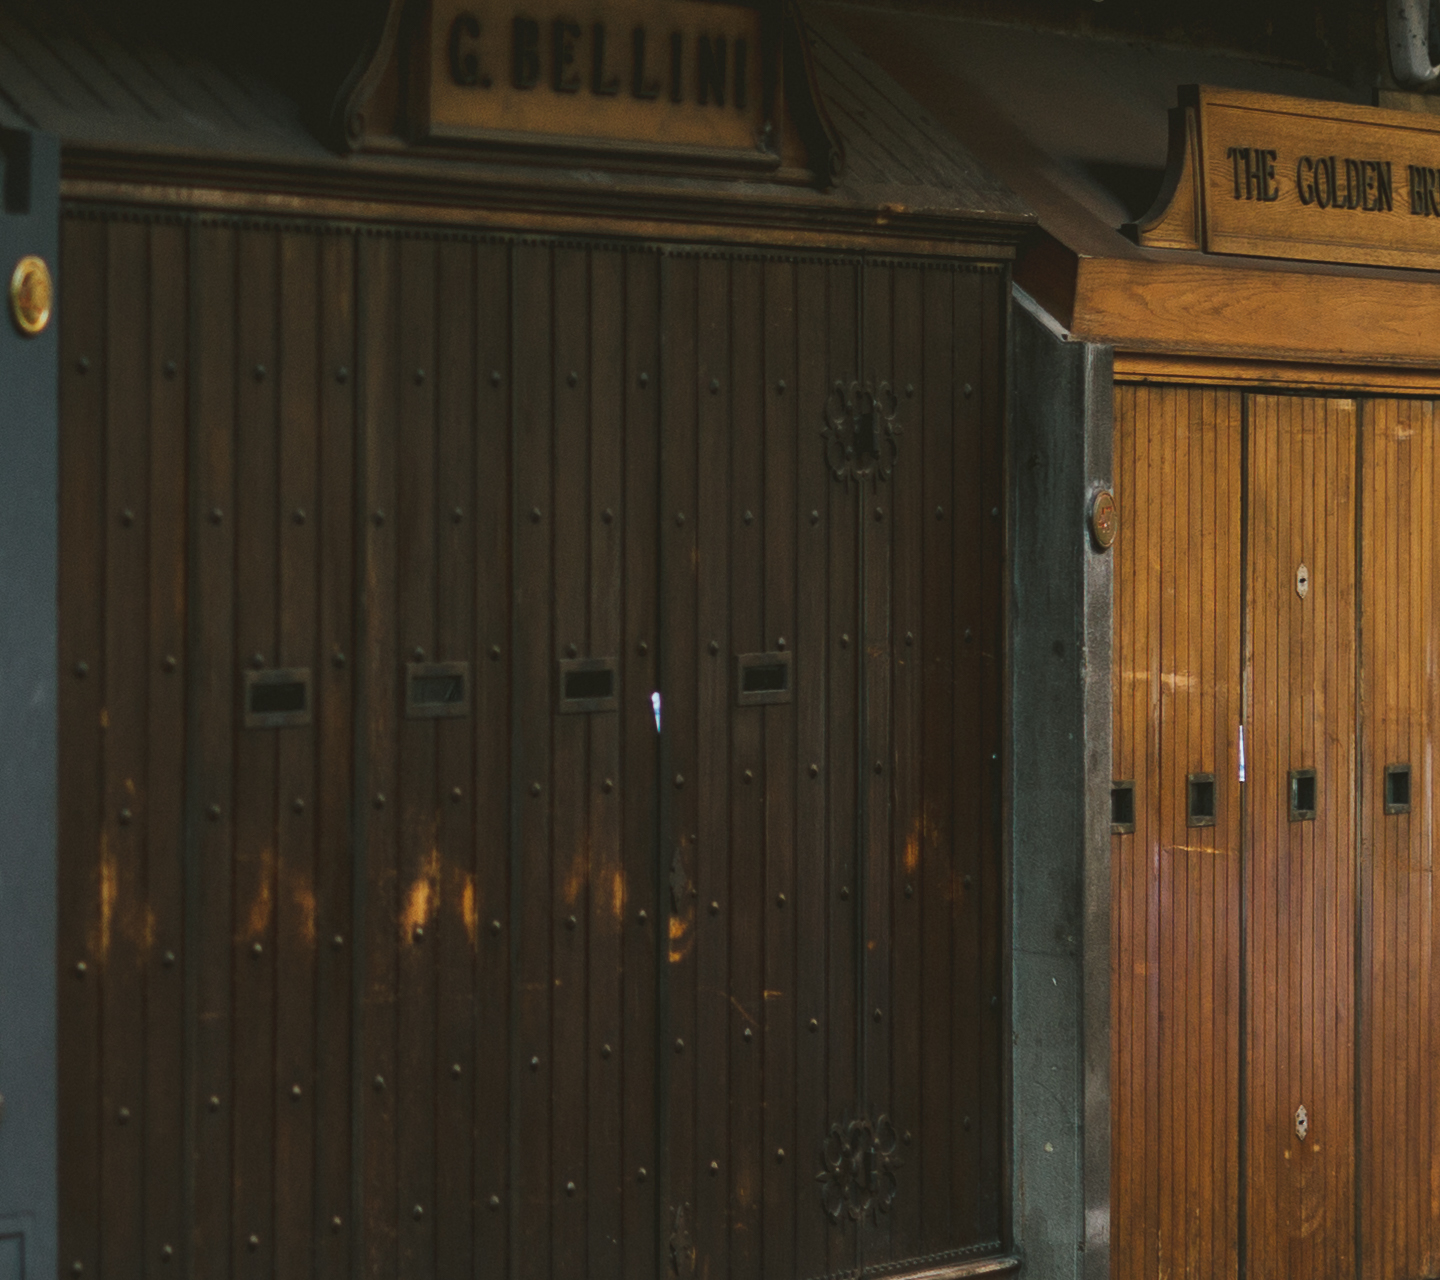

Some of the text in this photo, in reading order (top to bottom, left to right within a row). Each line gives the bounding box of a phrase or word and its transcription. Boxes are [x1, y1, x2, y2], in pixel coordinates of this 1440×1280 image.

[511, 15, 748, 111] BELLINI
[1226, 145, 1280, 203] THE
[1296, 154, 1394, 213] GOLDEN
